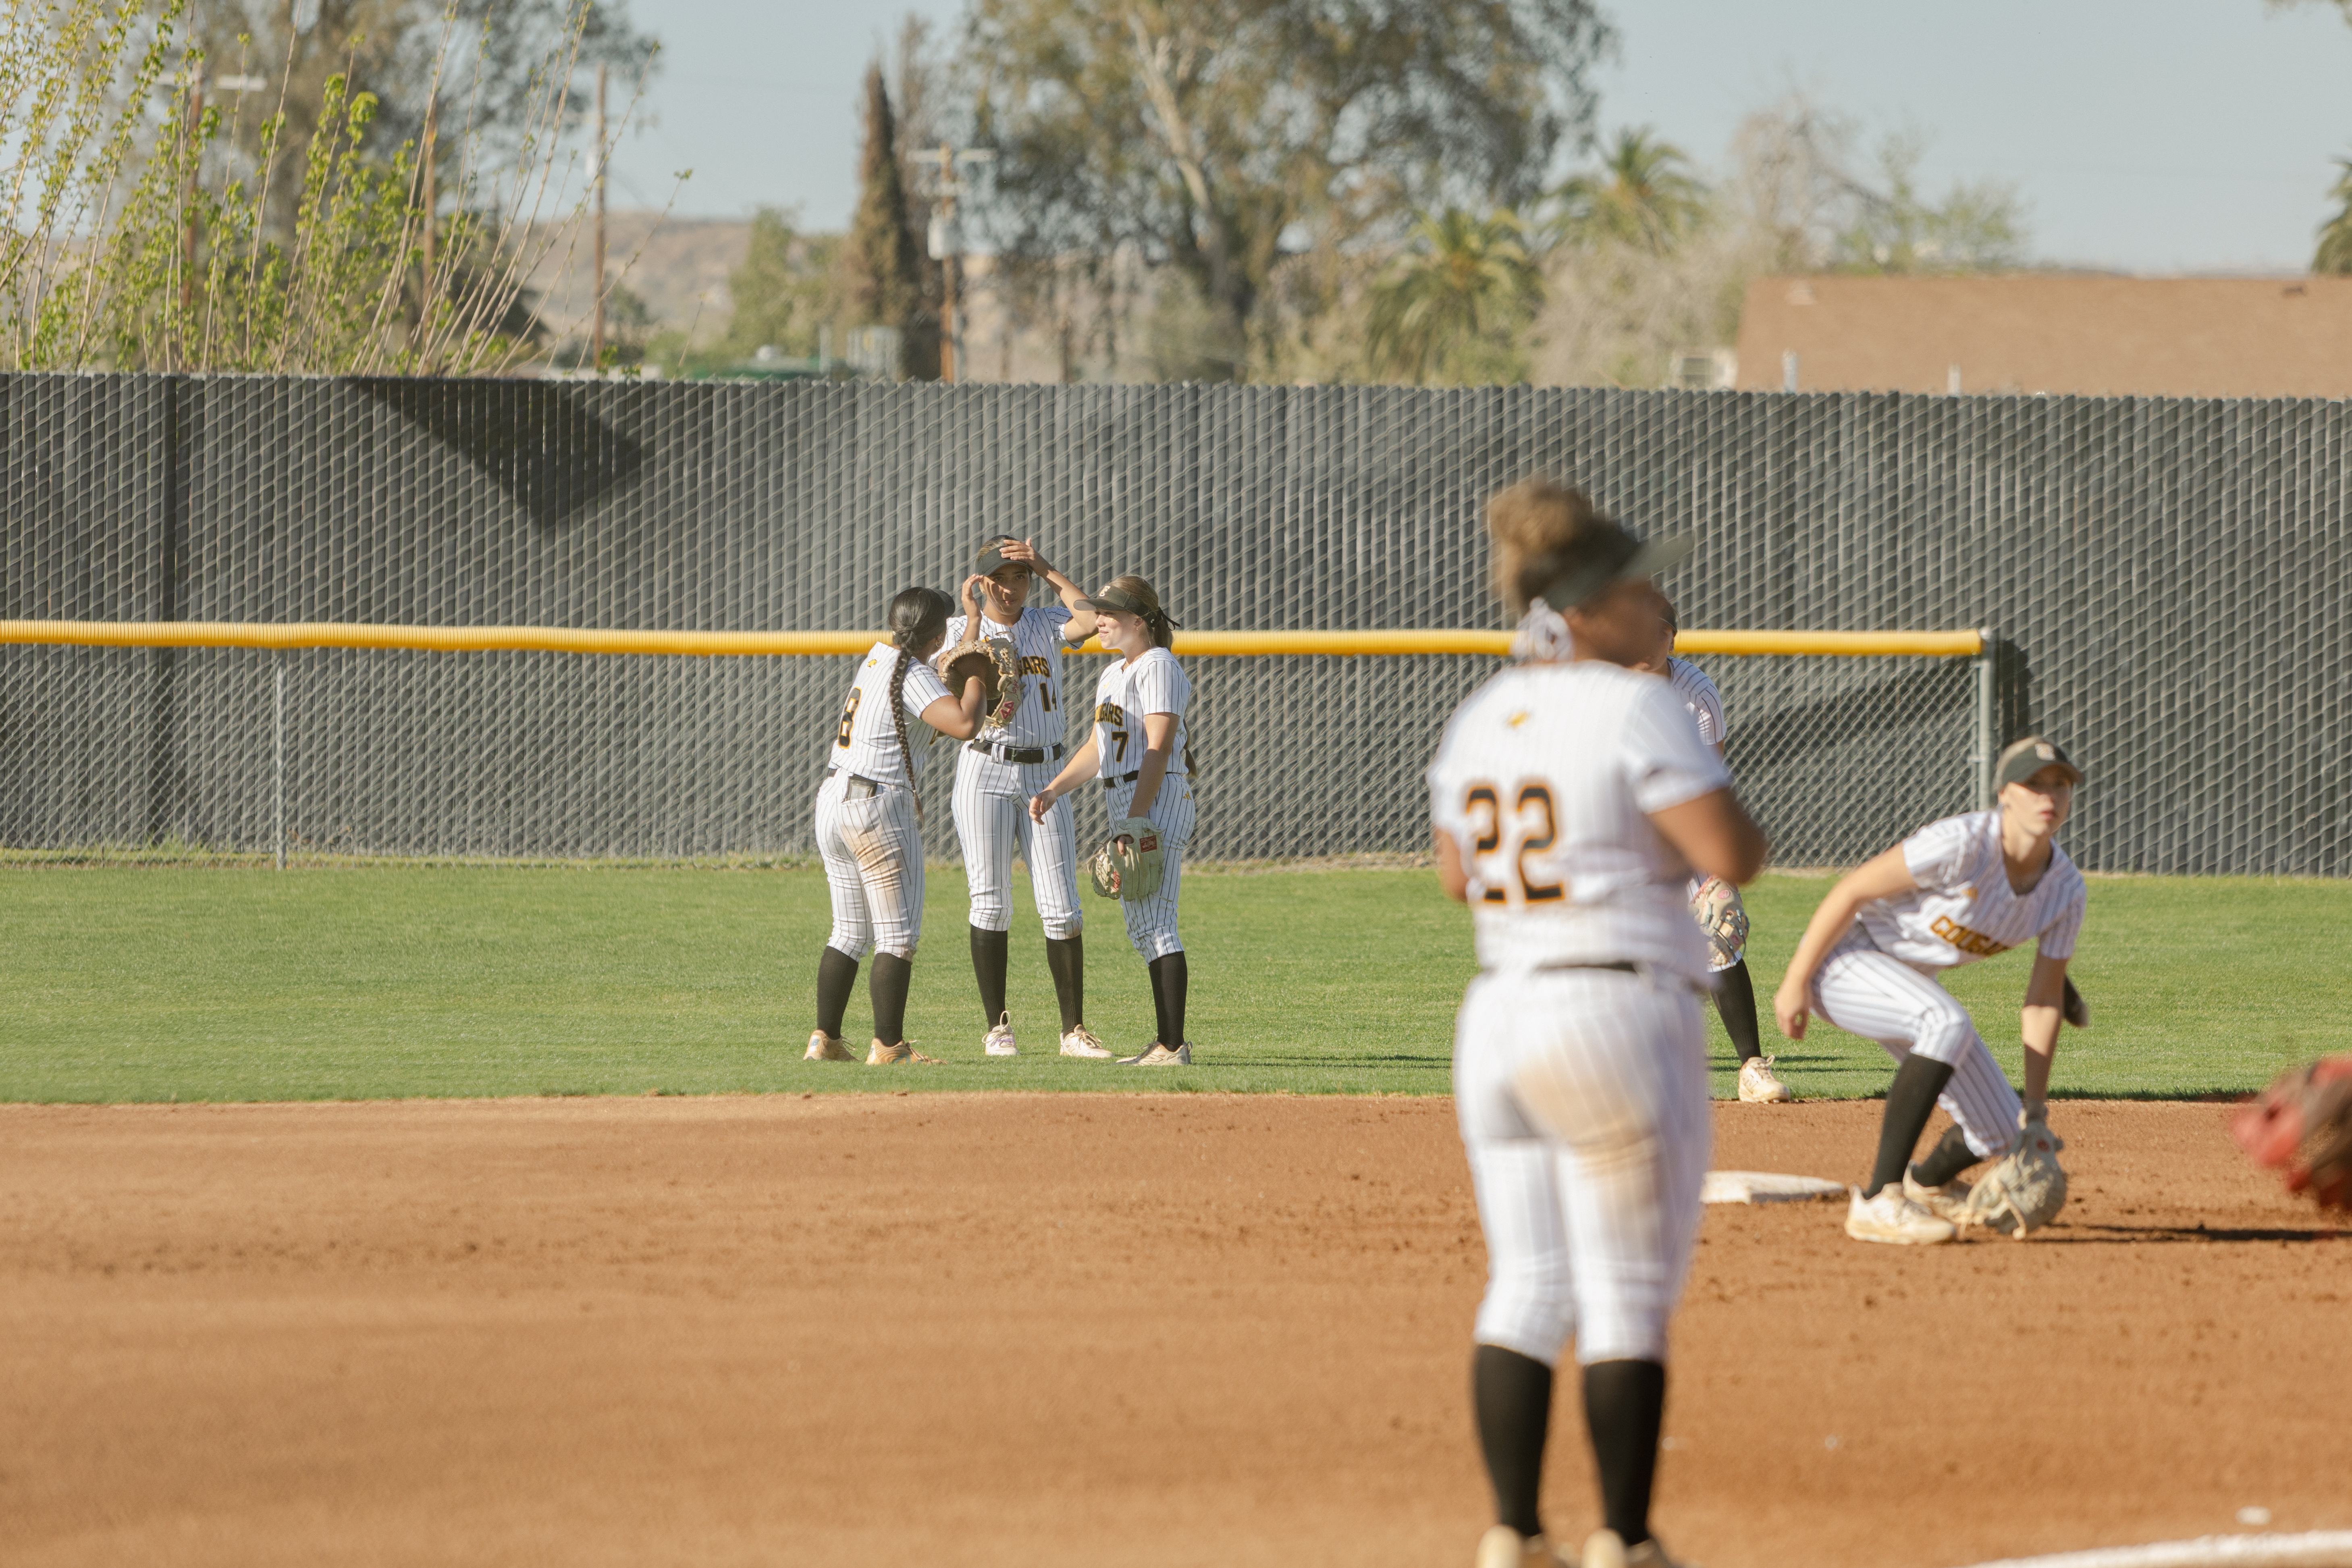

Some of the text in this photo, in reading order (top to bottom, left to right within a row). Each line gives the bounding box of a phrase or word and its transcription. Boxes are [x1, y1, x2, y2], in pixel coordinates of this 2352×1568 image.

[1000, 700, 1014, 720] 44
[1111, 731, 1129, 763] 7
[1464, 783, 1565, 903] 22
